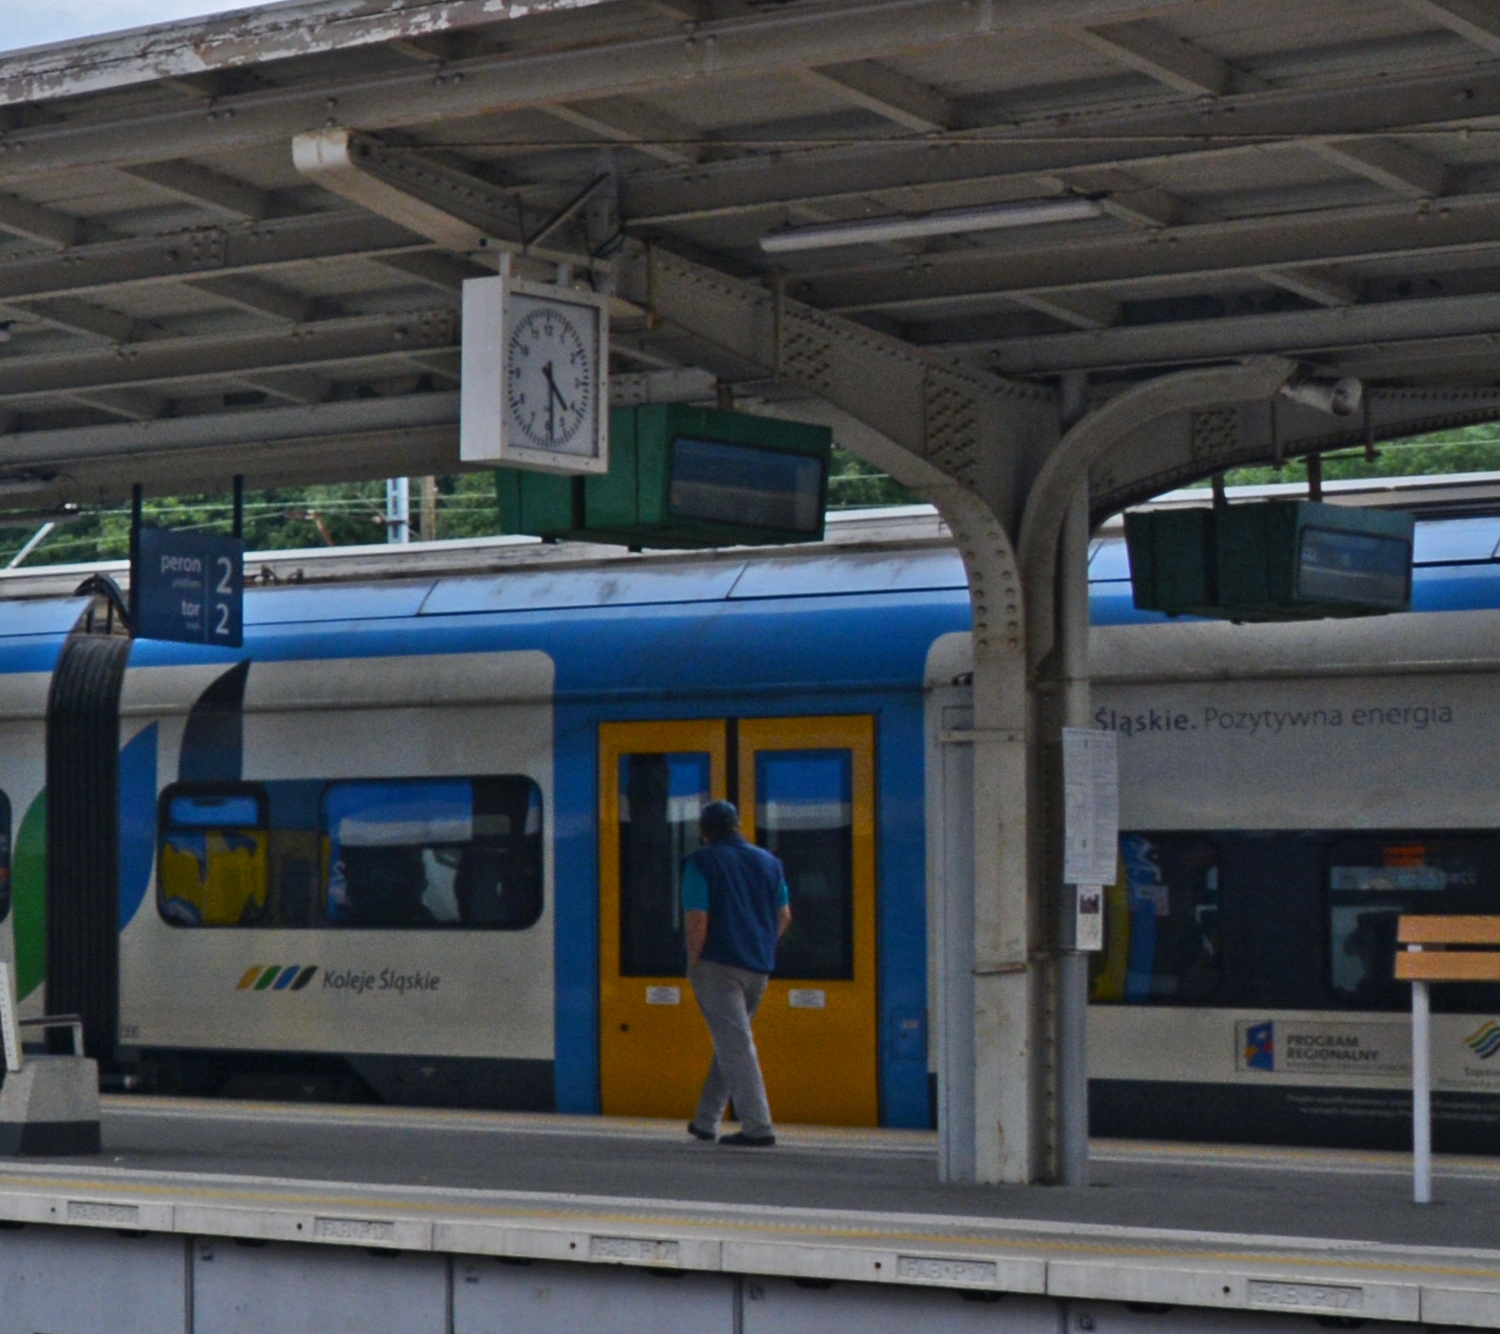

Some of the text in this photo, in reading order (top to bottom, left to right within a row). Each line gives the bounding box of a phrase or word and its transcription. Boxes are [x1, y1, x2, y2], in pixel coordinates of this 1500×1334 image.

[160, 555, 233, 594] peron 2
[182, 599, 229, 635] tor 2
[1203, 707, 1343, 735] Pozytywna
[1352, 703, 1454, 729] energia
[322, 966, 441, 995] Koleje Śląskie
[1286, 1034, 1360, 1048] PROGRAM
